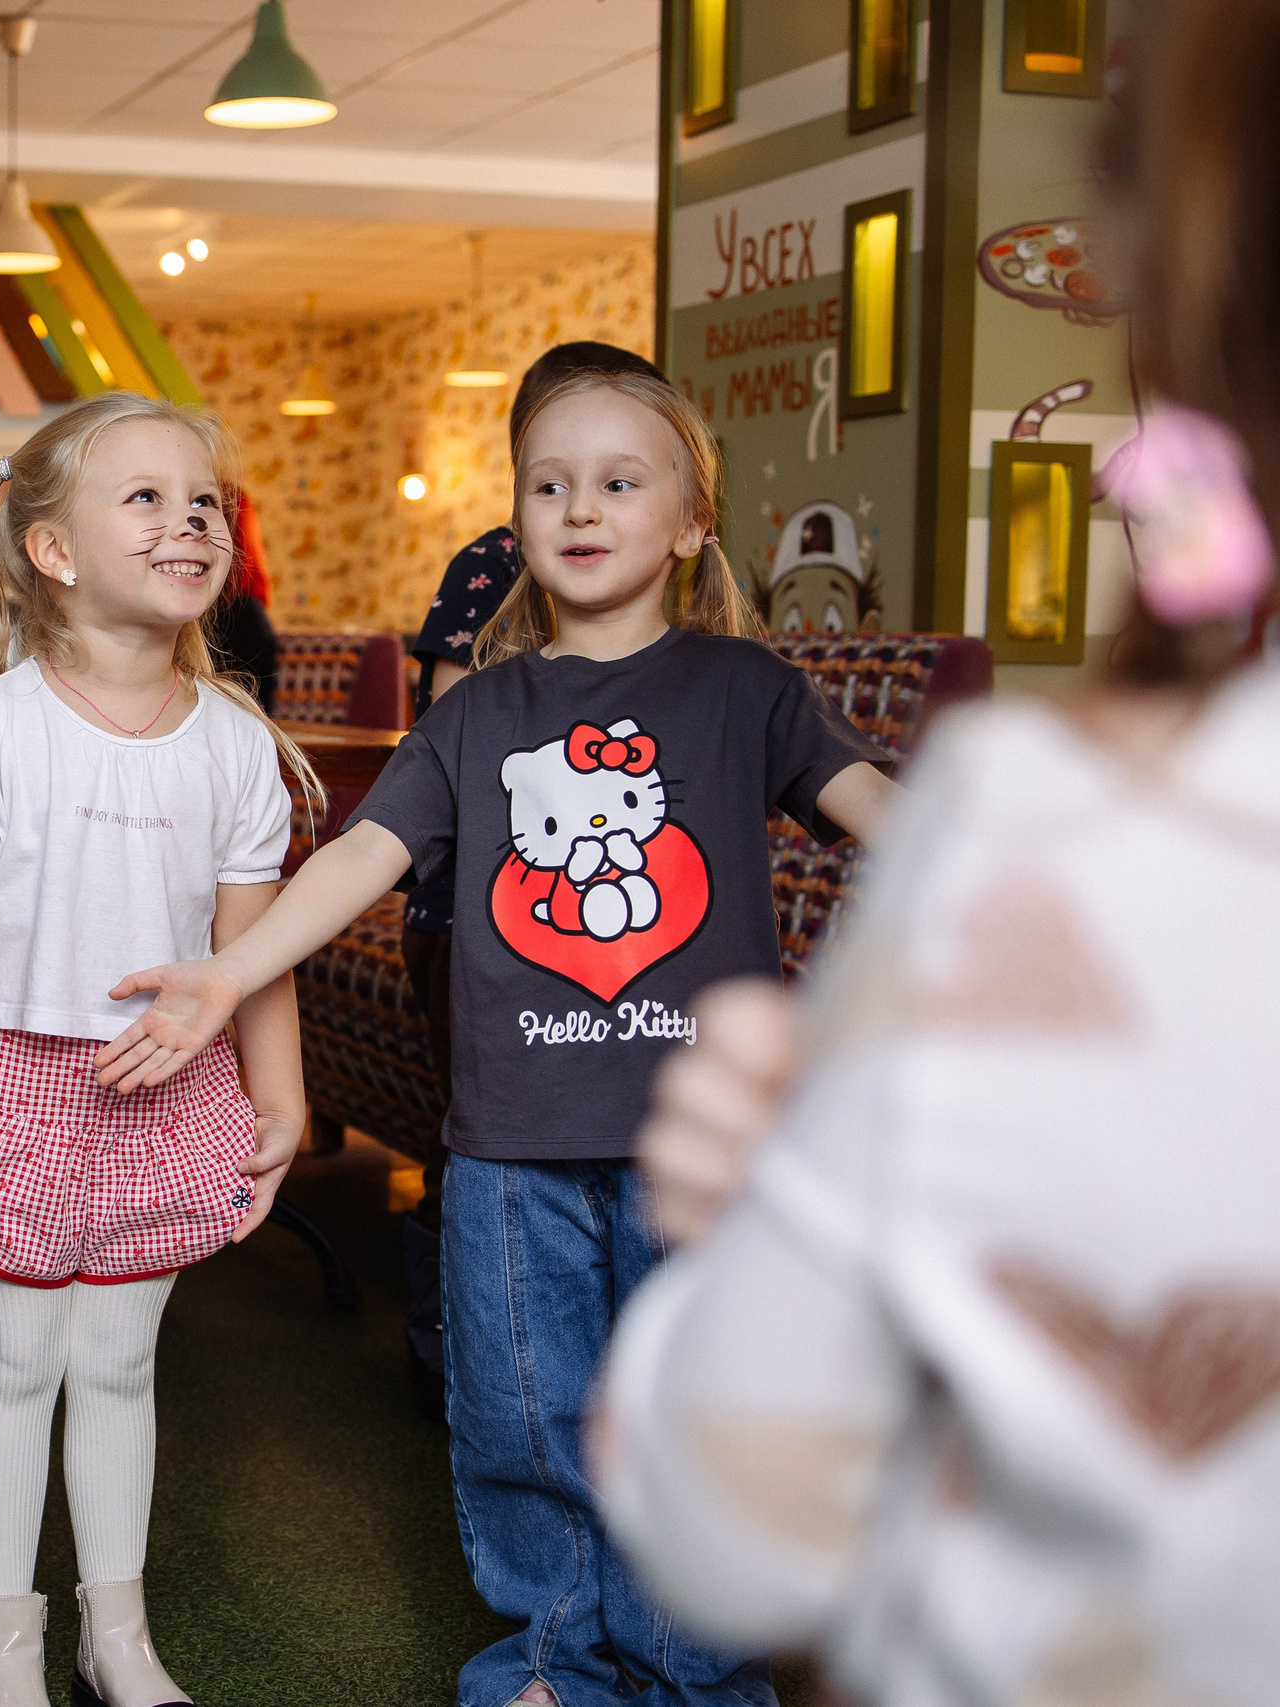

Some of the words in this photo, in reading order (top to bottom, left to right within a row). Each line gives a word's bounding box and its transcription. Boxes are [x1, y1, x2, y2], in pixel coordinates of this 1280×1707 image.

[75, 805, 93, 819] FIND
[93, 810, 109, 822] JOY
[145, 817, 173, 829] THINGS
[518, 1010, 612, 1046] Hello
[617, 999, 697, 1046] Kitty
